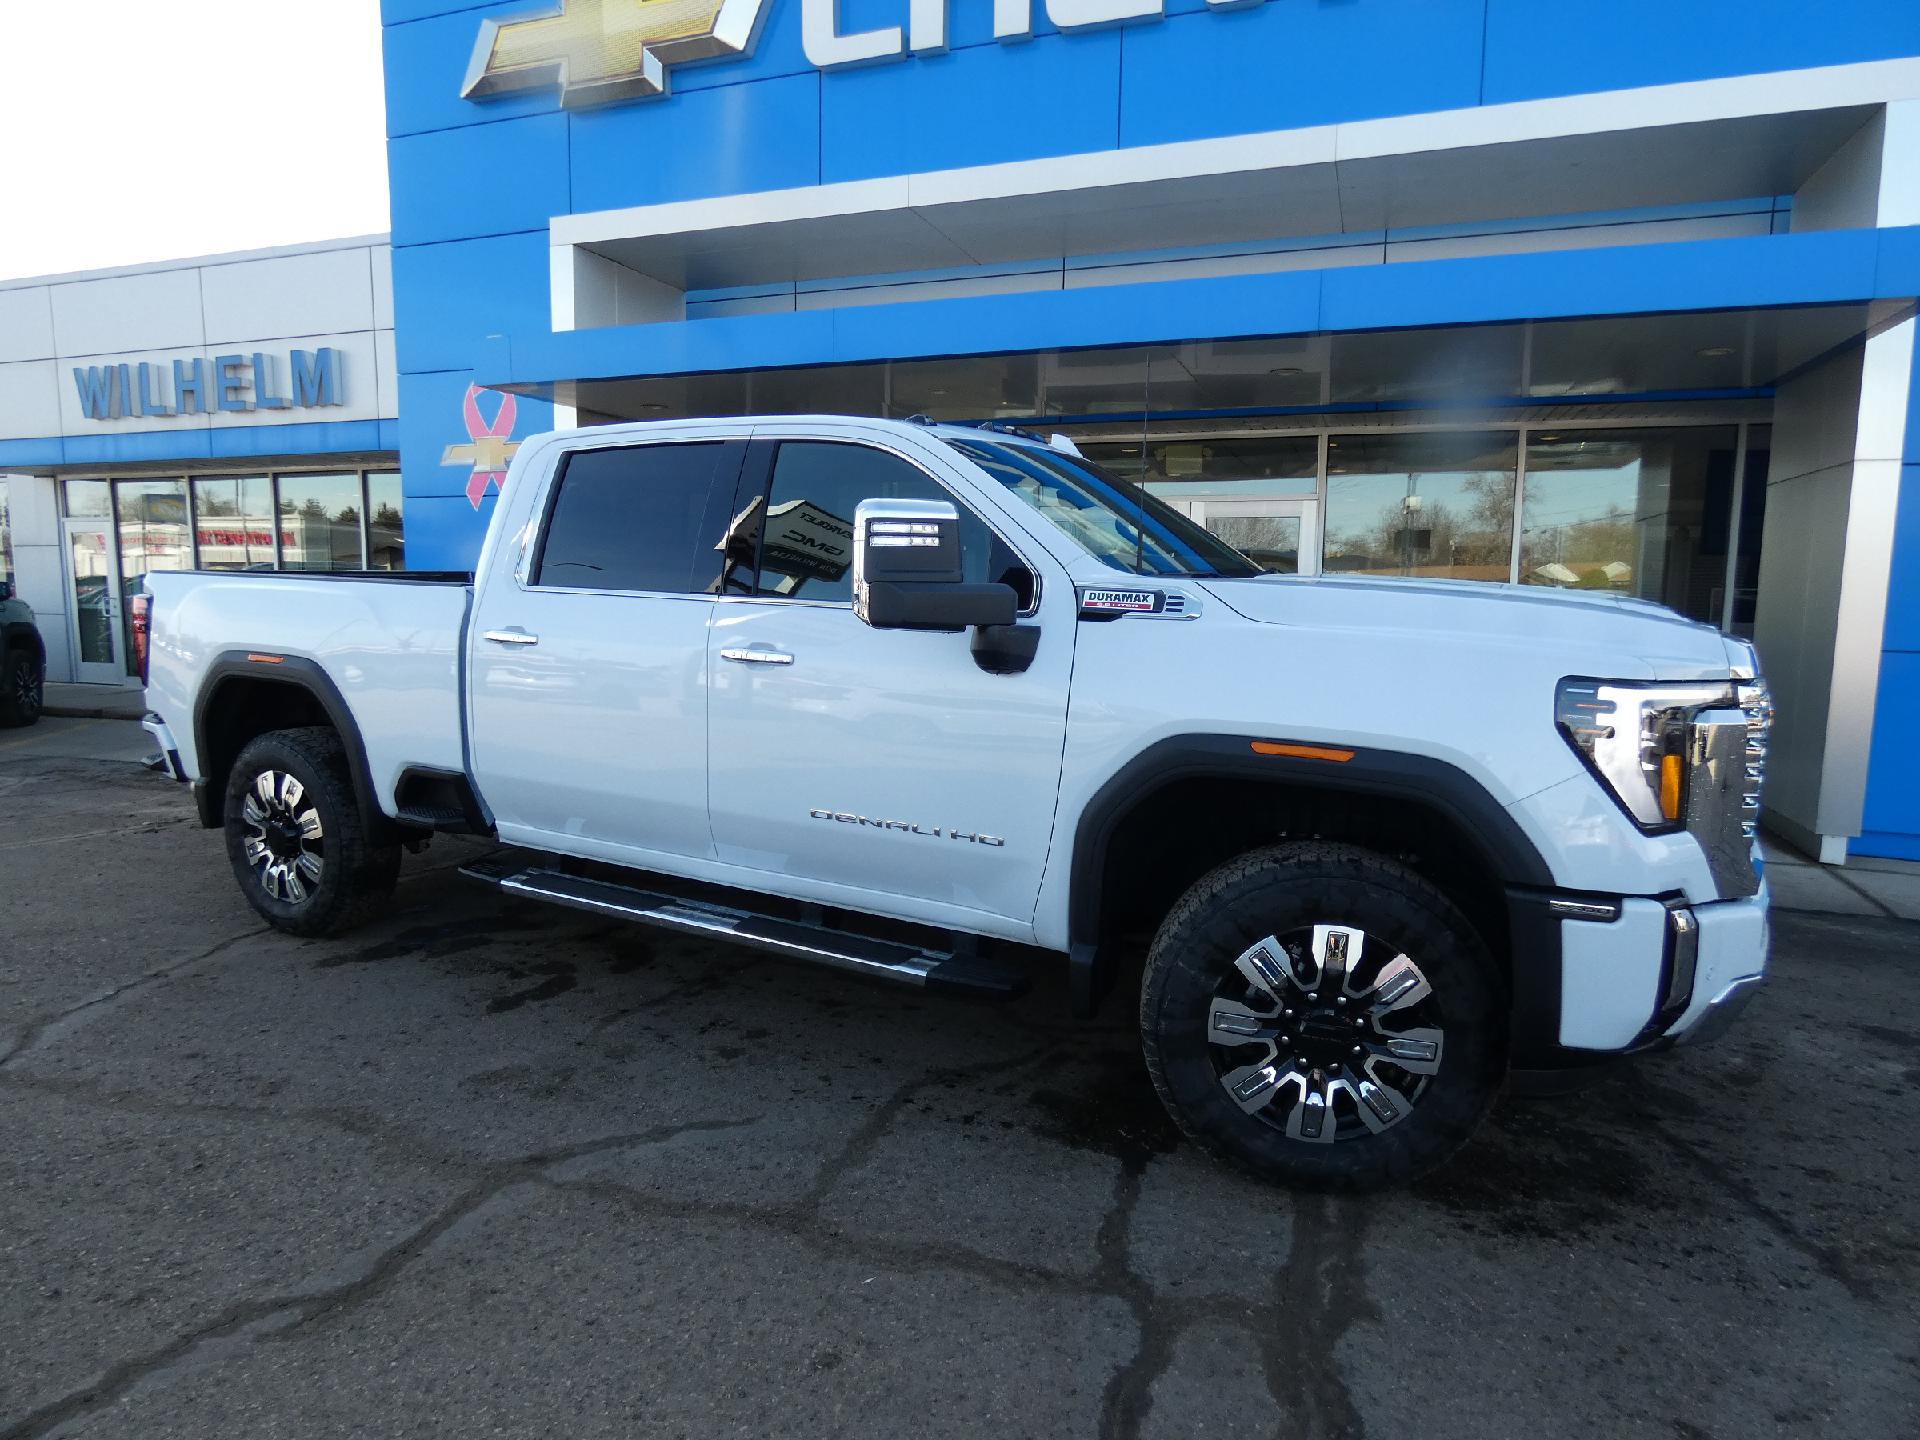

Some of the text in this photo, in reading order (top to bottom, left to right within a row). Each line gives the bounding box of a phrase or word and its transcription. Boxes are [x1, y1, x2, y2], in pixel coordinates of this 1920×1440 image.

[73, 347, 340, 420] WILHELM
[1088, 592, 1151, 603] DURAMAX
[810, 808, 1005, 846] DENALI HD
